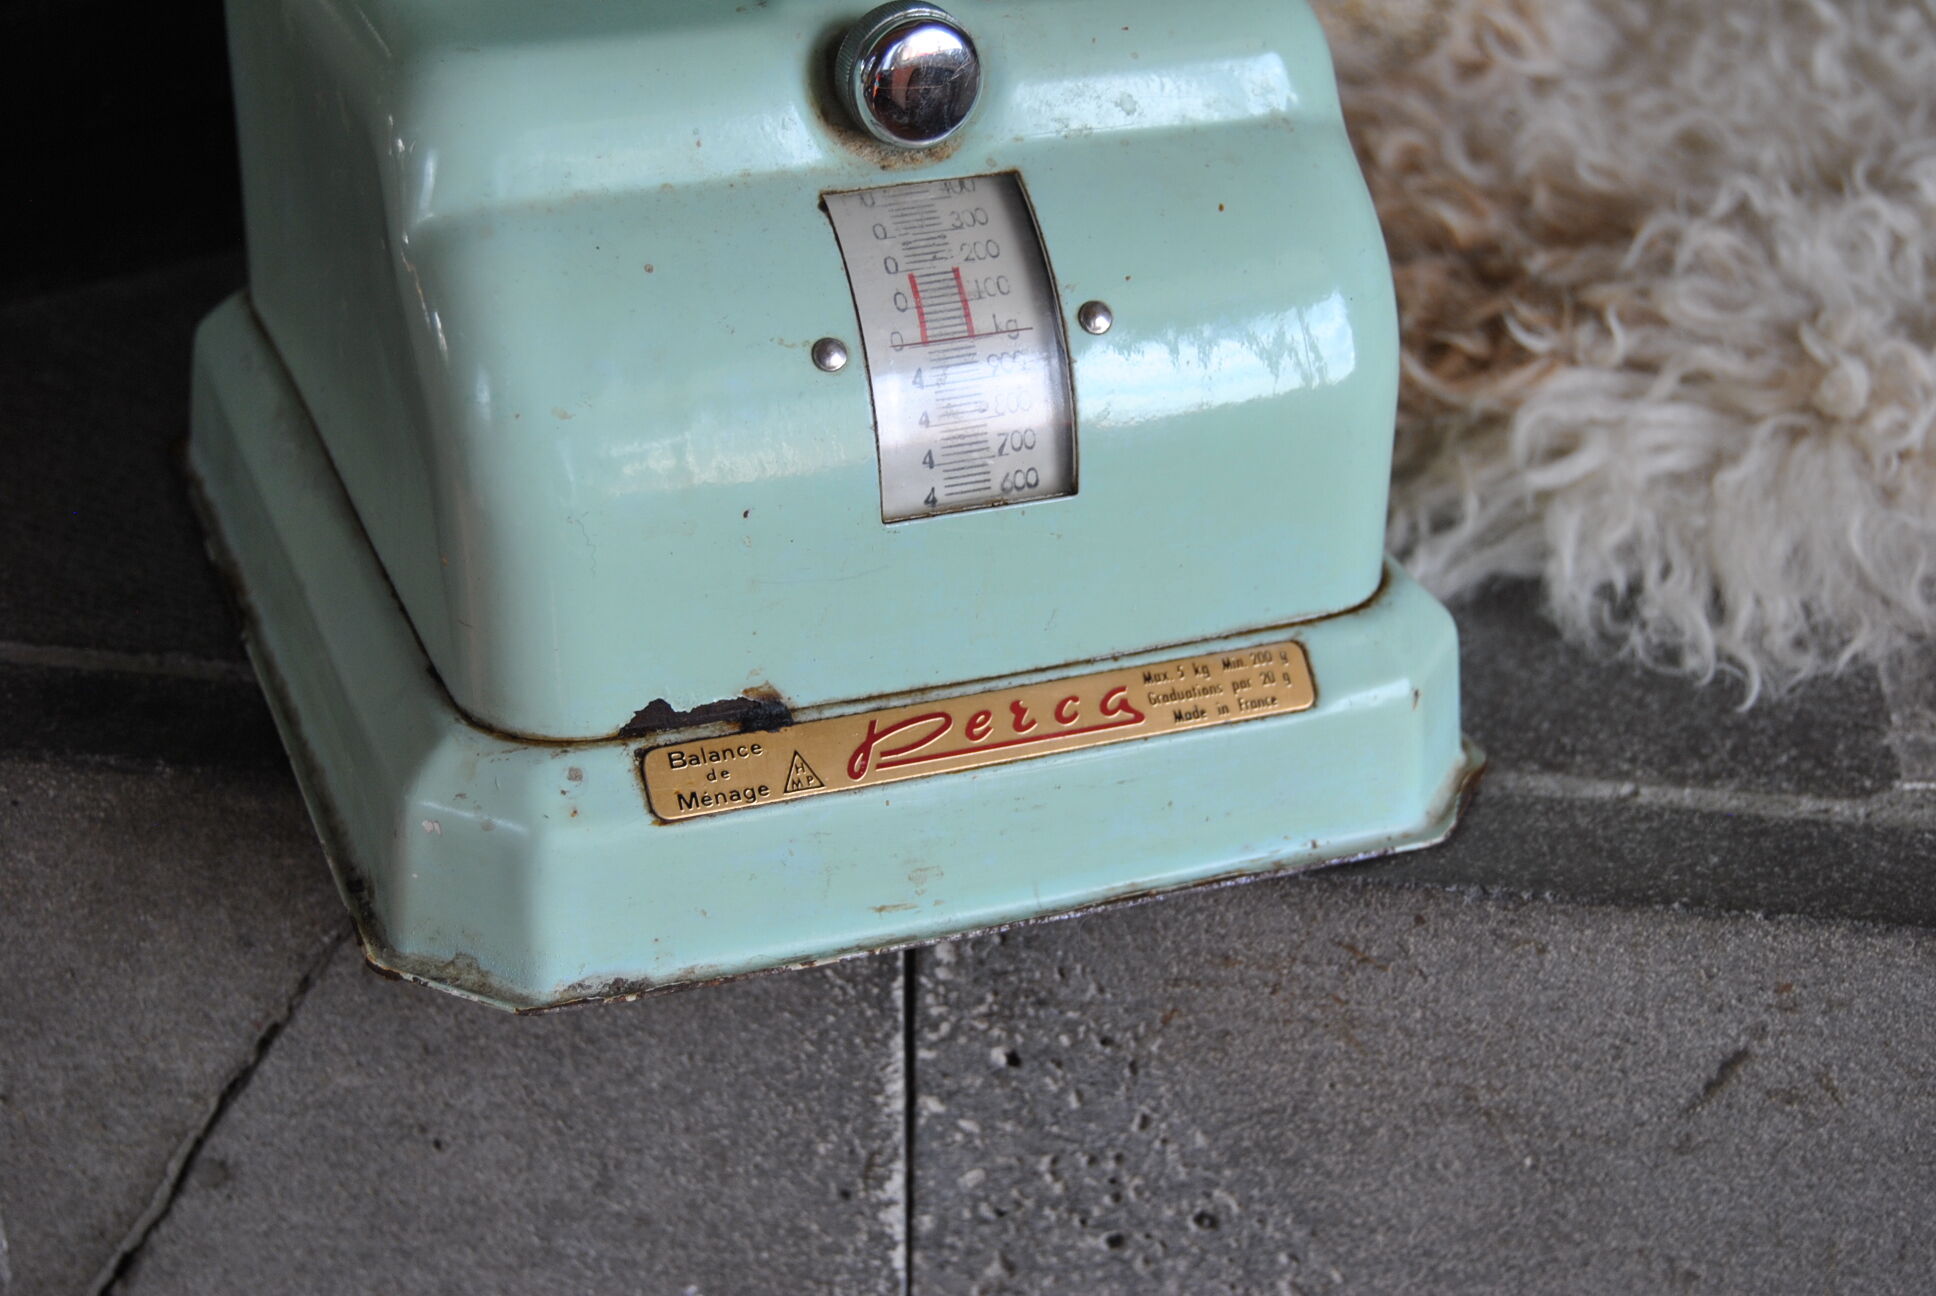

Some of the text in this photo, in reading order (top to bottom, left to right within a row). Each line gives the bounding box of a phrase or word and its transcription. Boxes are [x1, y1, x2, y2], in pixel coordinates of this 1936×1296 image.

[872, 207, 989, 240] 0 300
[884, 239, 1001, 275] 0 200
[893, 275, 1011, 312] 0 100
[890, 314, 1020, 352] 0 kg
[912, 367, 925, 389] 4
[918, 411, 931, 428] 4
[922, 428, 1037, 469] 4 700
[924, 466, 1039, 508] 4 600
[1143, 650, 1289, 684] Max. 5 kg Min. 200 g
[1147, 670, 1292, 706] Graduations par 20 g
[1173, 694, 1278, 723] Made in France
[847, 685, 1146, 780] Perca
[667, 742, 763, 770] Balance
[795, 762, 806, 775] H
[706, 768, 731, 782] de
[791, 775, 815, 790] M P
[677, 784, 770, 811] Ménage
